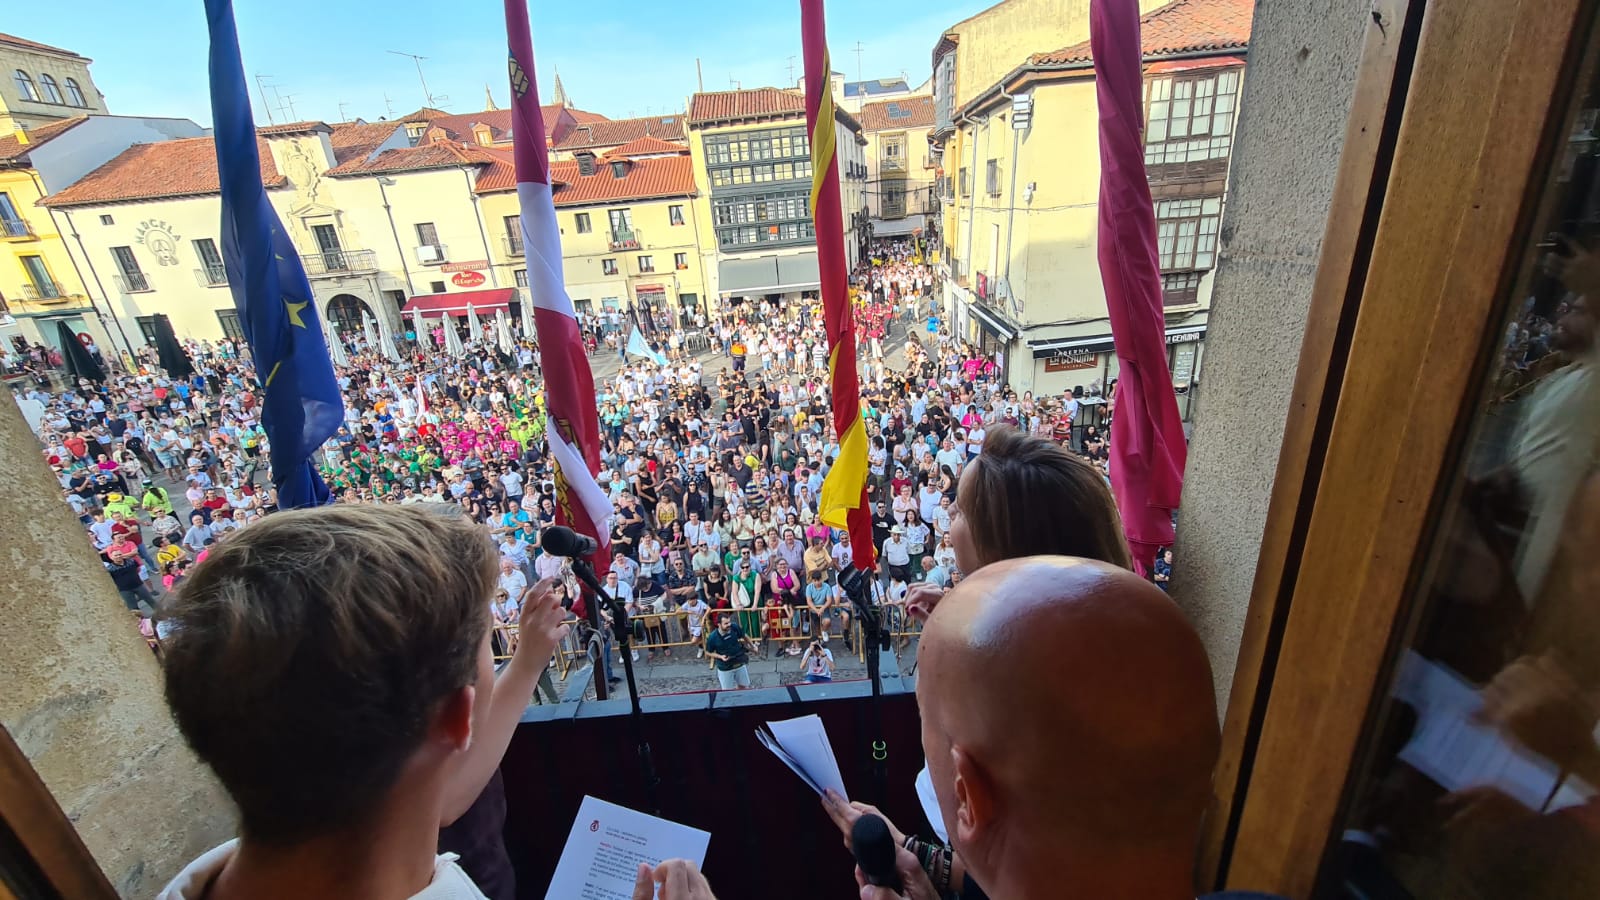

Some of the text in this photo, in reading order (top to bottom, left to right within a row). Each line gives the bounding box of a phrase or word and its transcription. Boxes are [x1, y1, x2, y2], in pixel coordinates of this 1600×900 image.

[135, 219, 181, 245] MARCELA
[442, 263, 487, 272] Restaurante
[1053, 348, 1089, 357] TABERNA
